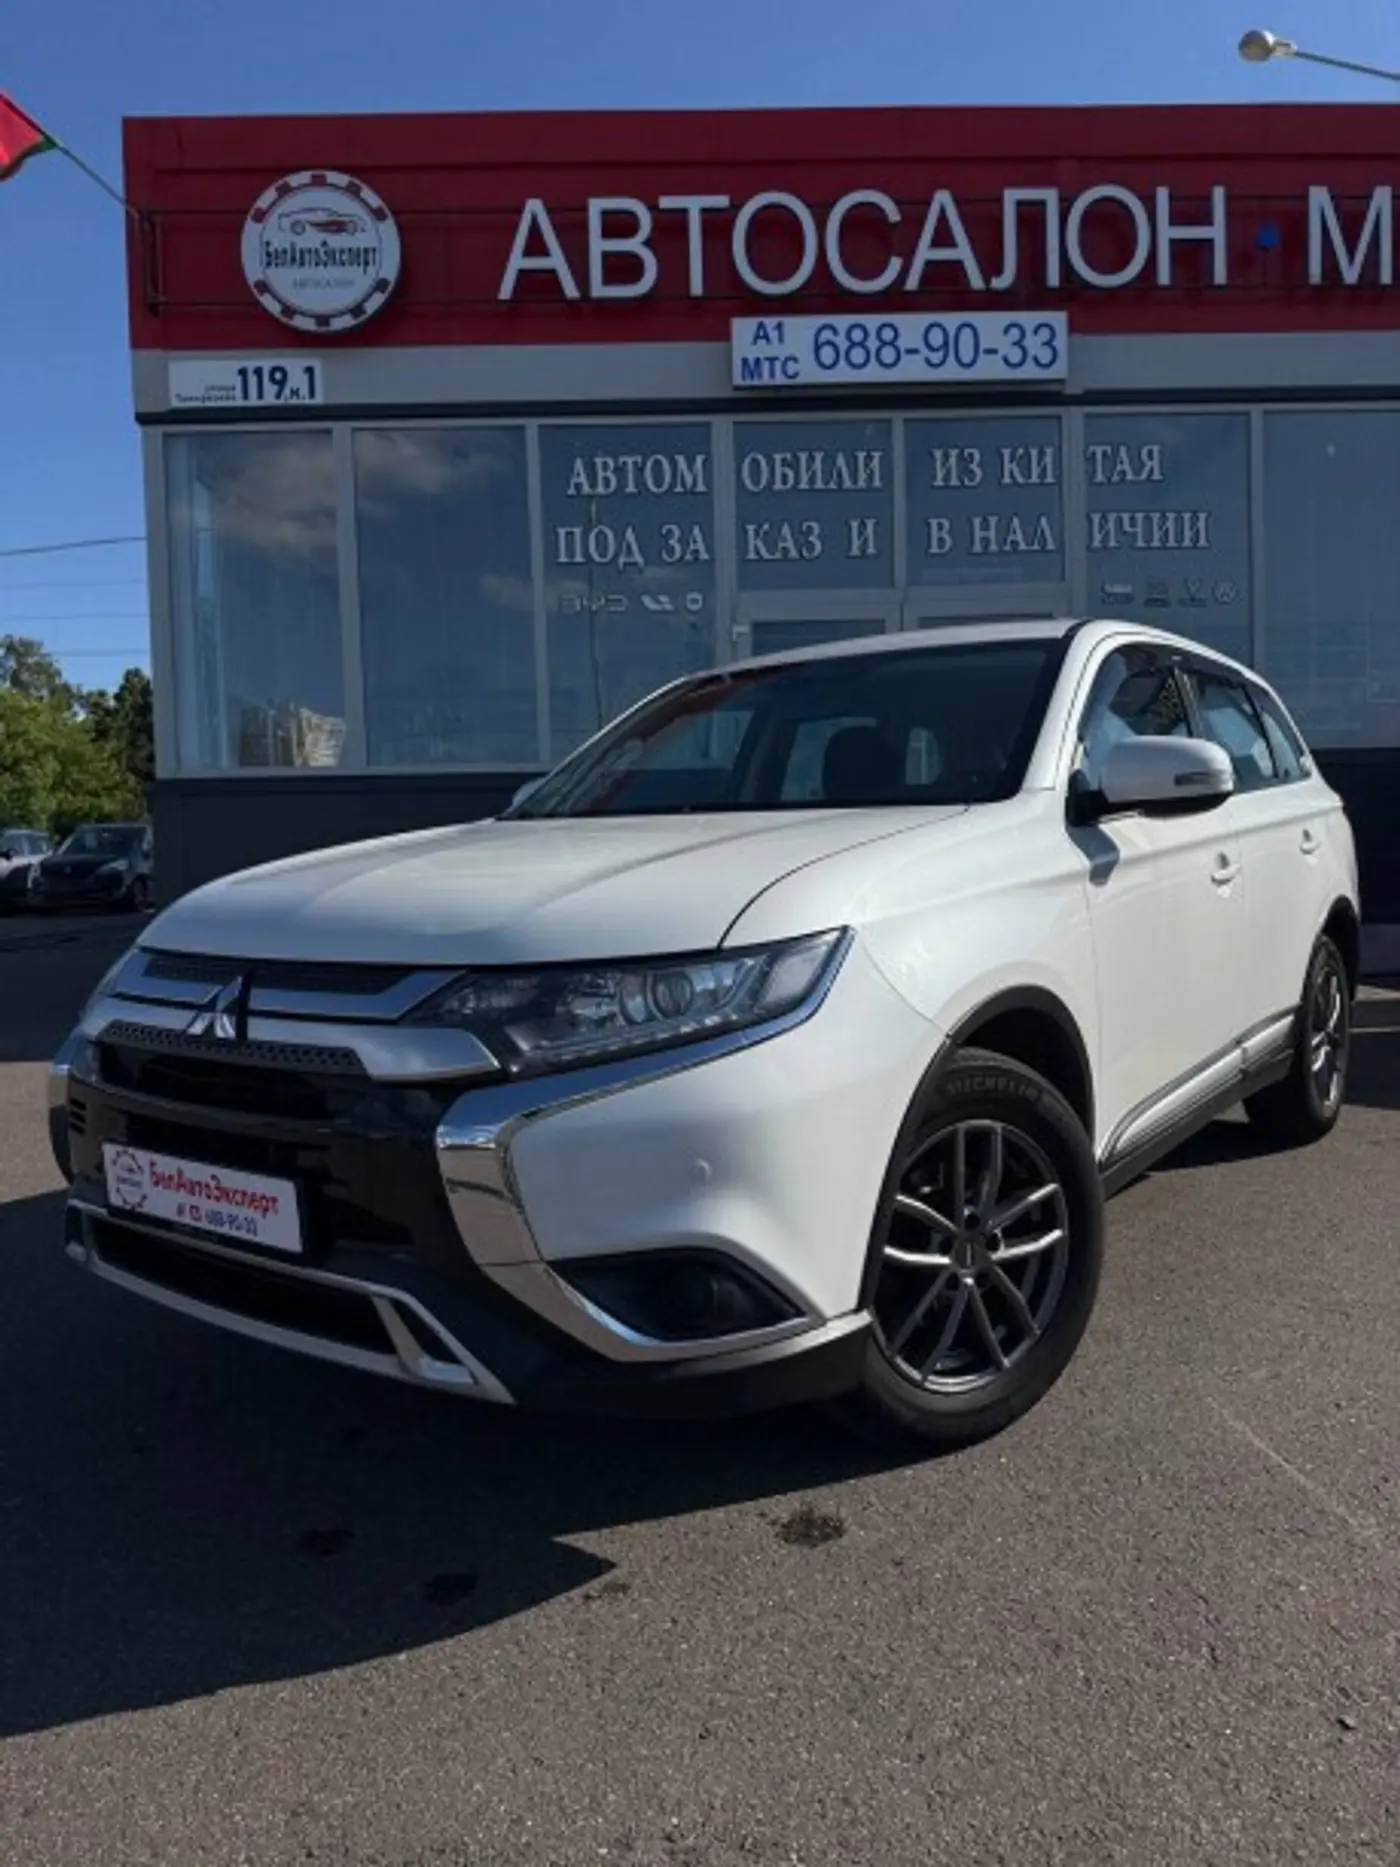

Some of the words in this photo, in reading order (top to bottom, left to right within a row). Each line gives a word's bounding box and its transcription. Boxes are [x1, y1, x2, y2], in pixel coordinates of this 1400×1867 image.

[498, 185, 1228, 302] АВТОСАЛОН
[741, 355, 799, 381] МТС
[813, 322, 1059, 370] 688-90-33
[566, 454, 708, 495] АВТОМ
[741, 451, 883, 491] ОБИЛИ
[932, 449, 983, 486] ИЗ
[1001, 447, 1056, 483] КИ
[1088, 445, 1163, 482] ТАЯ
[556, 525, 644, 570] ПОД
[661, 524, 710, 562] ЗА
[745, 521, 822, 560] КАЗ
[849, 518, 877, 556] И
[928, 517, 953, 553] В
[972, 515, 1056, 552] НАЛ
[1090, 512, 1209, 548] ИЧИИ
